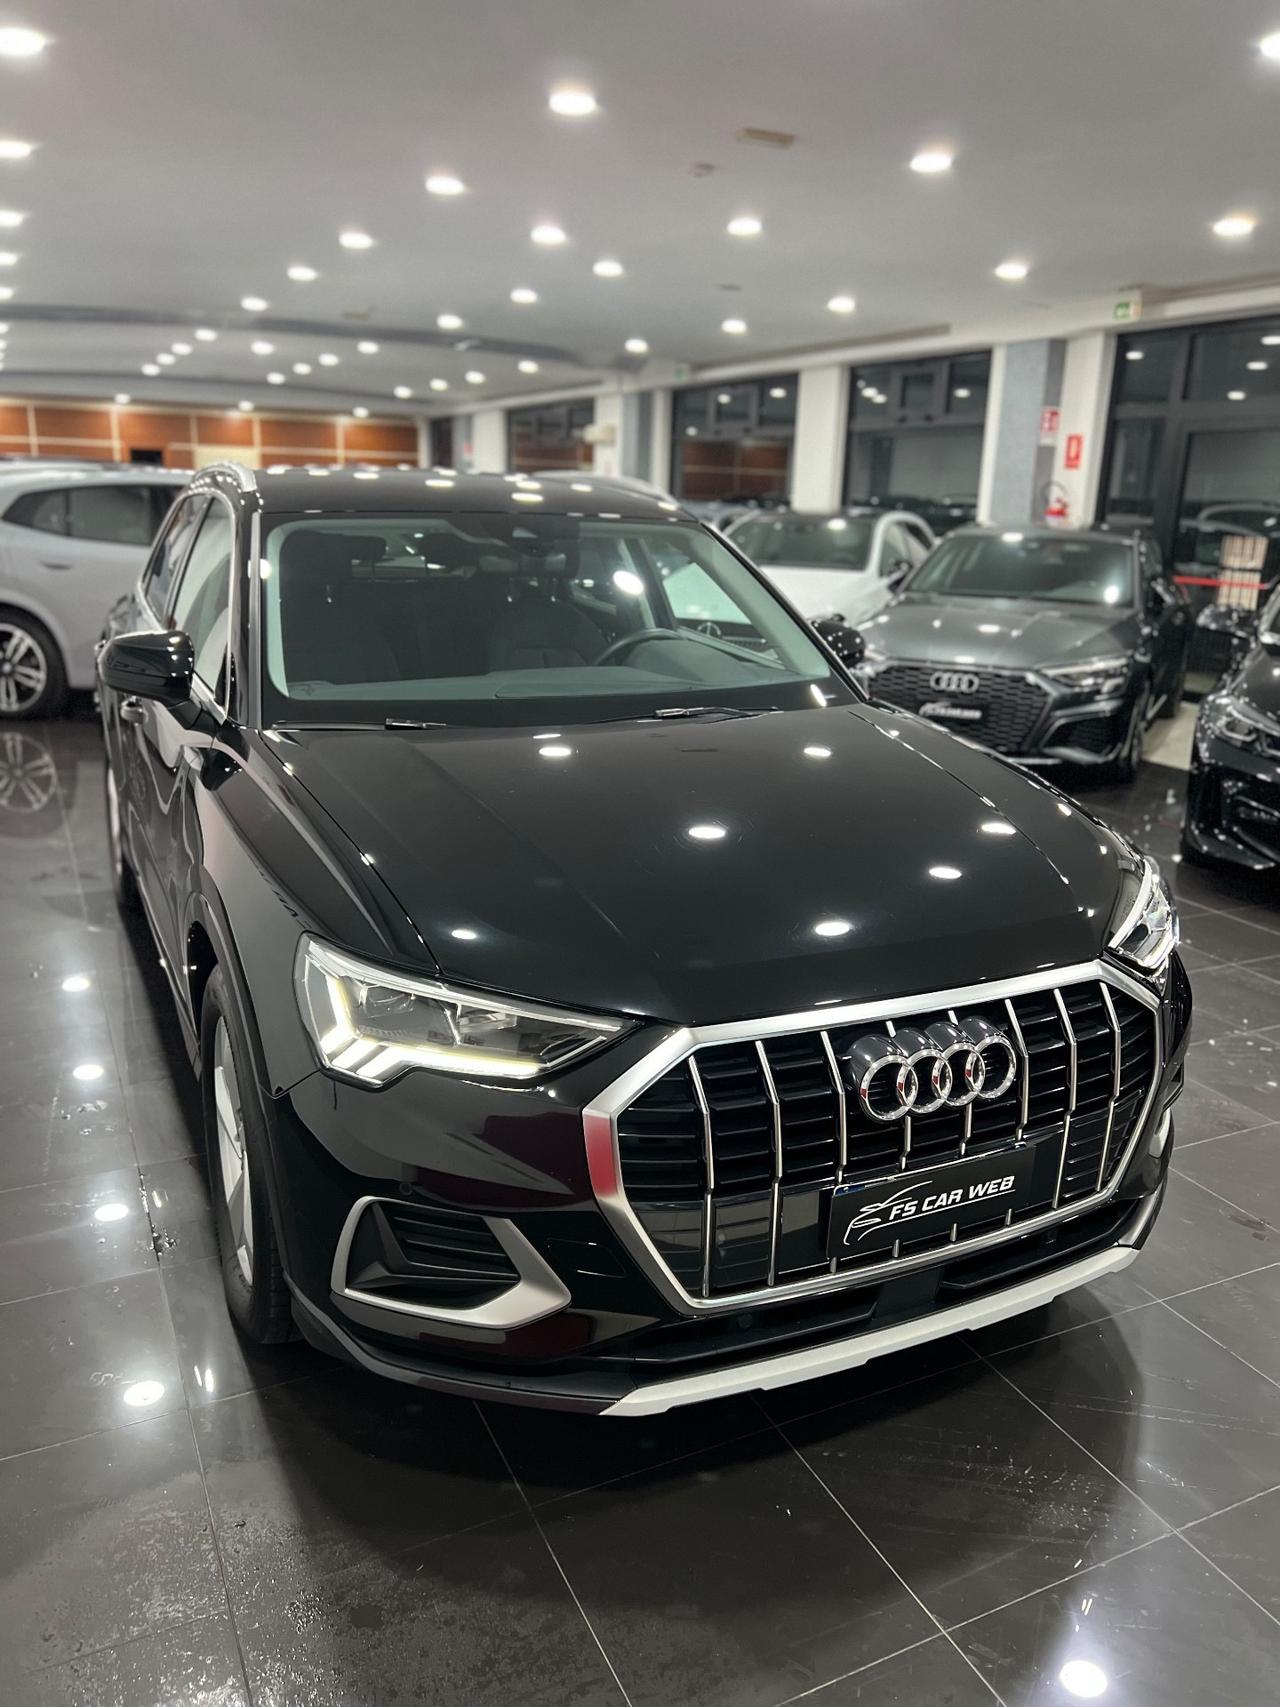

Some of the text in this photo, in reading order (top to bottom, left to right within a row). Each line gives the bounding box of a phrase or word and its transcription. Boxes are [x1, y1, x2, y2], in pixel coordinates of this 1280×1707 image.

[890, 1176, 1015, 1220] FS CAR WEB
